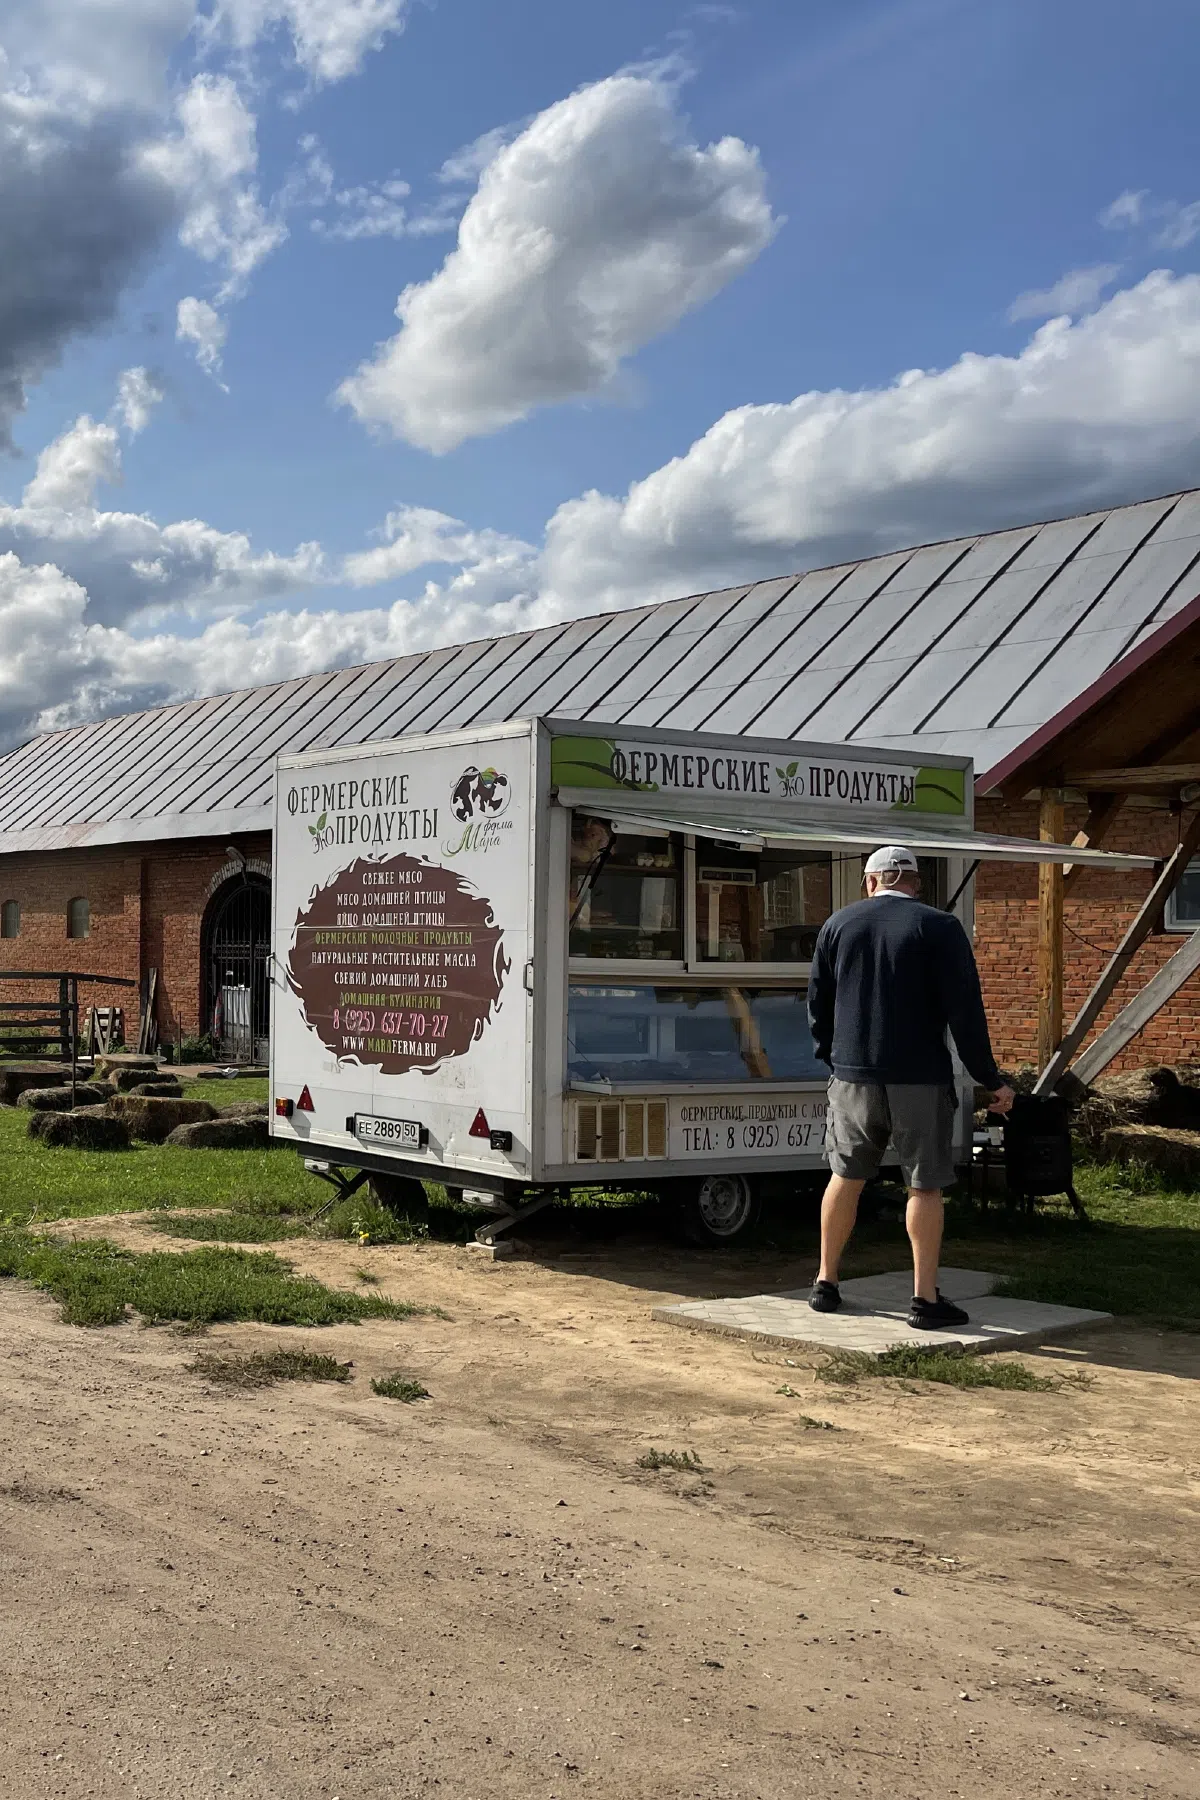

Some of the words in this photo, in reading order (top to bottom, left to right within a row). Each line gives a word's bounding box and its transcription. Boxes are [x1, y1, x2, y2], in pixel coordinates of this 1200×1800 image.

[610, 748, 770, 794] ФЕРМЕРСКИЕ
[809, 766, 916, 804] ПРОДУКТЫ
[287, 774, 410, 816] ФЕРМЕРСКИЕ
[335, 808, 439, 846] ПРОДУКТЫ
[362, 872, 395, 885] СВЕЖЕЕ
[398, 870, 423, 885] МЯСО
[336, 893, 359, 906] МЯСО
[362, 891, 411, 906] ДОМАШНЕЙ
[414, 890, 446, 905] ПТИЦЫ
[336, 912, 359, 926] ЯЙЦО
[362, 911, 410, 926] ДОМАШНЕЙ
[413, 912, 446, 926] ПТИЦЫ
[315, 932, 367, 945] ФЕРМЕРСКИЕ
[371, 932, 420, 945] МОЛОЧНЫЕ
[423, 931, 472, 946] ПРОДУКТЫ
[311, 951, 369, 965] НАТУРАЛЬНЫЕ
[372, 952, 440, 967] РАСТИТЕЛЬНЫЕ
[444, 953, 476, 967] МАСЛА
[334, 971, 367, 985] СВЕЖИЙ
[370, 972, 420, 988] ДОМАШНИЙ
[424, 974, 448, 988] ХЛЕБ
[340, 992, 386, 1007] ДОМАШНЯЯ
[389, 993, 441, 1010] КУЛИНАРИЯ
[332, 1008, 341, 1030] 8
[345, 1009, 376, 1032] (925)
[381, 1011, 449, 1038] 637-70-27
[341, 1035, 437, 1057] WWW.MARAFERMA.RU
[681, 1105, 744, 1122] ФЕРМЕРСКИЕ
[748, 1103, 797, 1121] ПРОДУКТЫ
[812, 1103, 828, 1119] ДОС
[373, 1120, 402, 1139] 2889
[404, 1123, 416, 1137] 50
[726, 1126, 735, 1149] 8
[742, 1124, 780, 1148] (925)
[787, 1123, 828, 1147] 637-7
